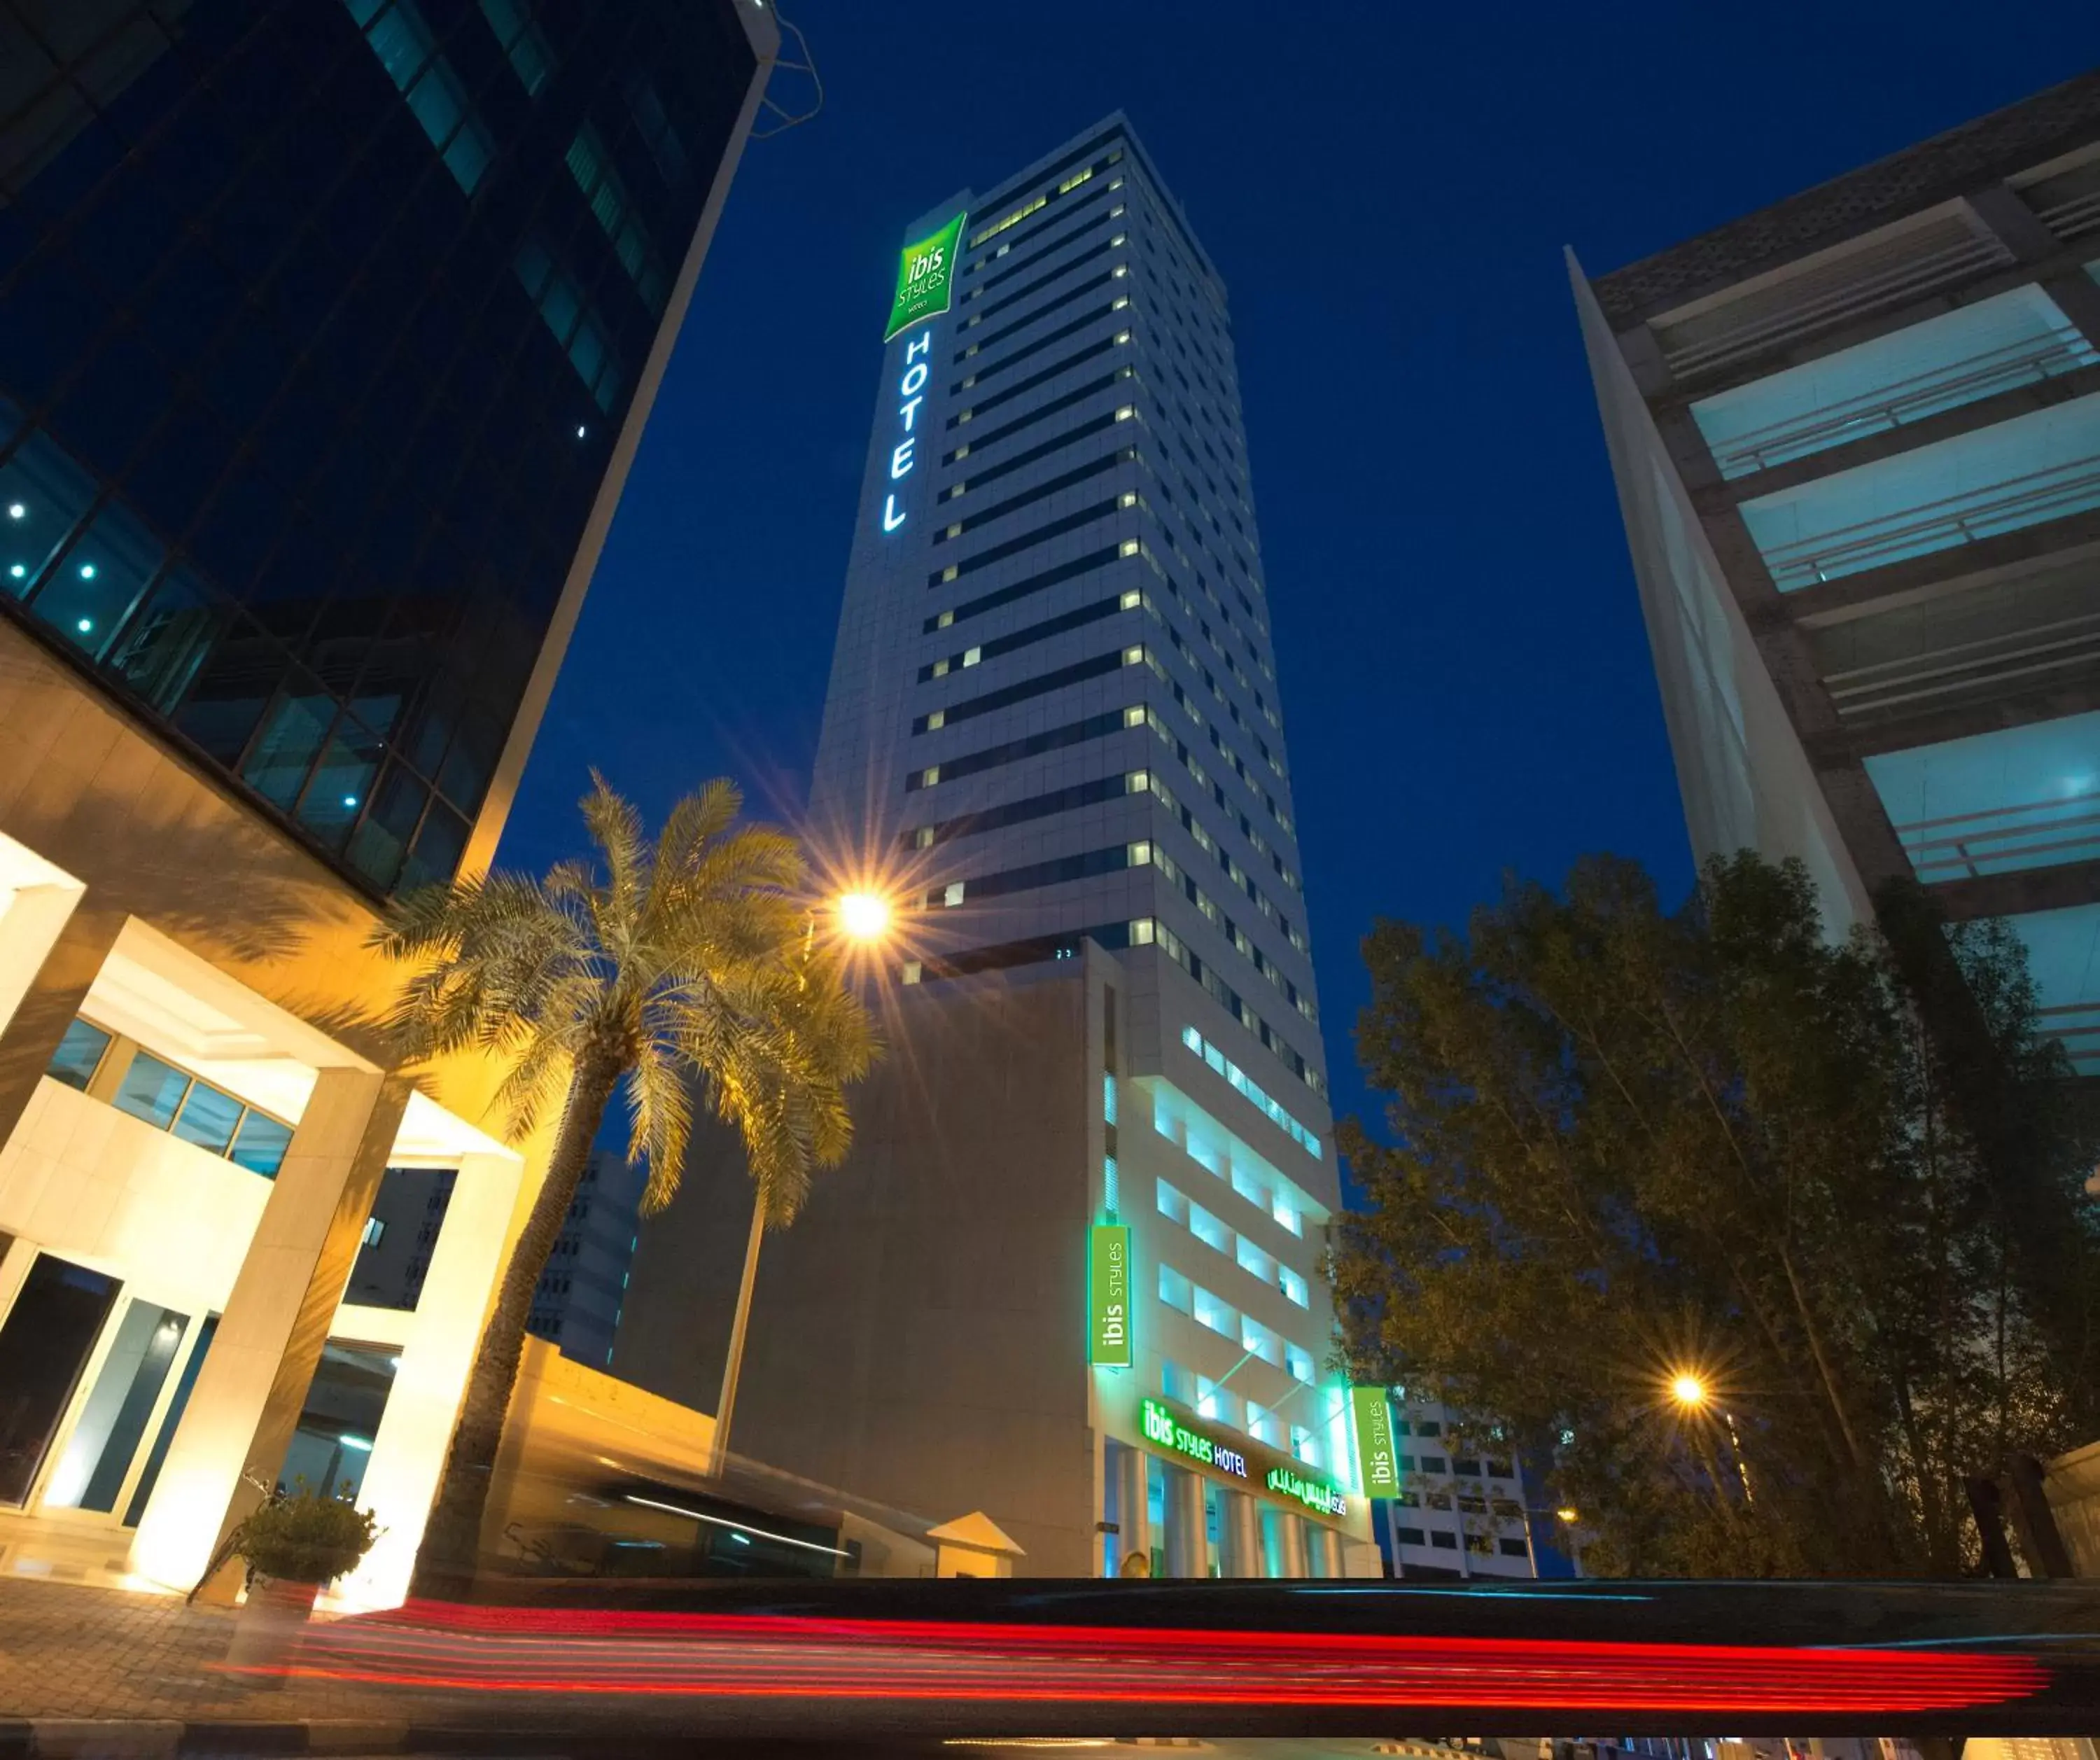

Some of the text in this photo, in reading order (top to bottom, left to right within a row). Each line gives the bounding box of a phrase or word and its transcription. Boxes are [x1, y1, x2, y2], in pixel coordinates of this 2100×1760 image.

[909, 246, 944, 284] ibis
[885, 332, 930, 531] HOTEL
[1102, 1304, 1123, 1346] ibis
[1144, 1399, 1173, 1446] ibis
[1214, 1445, 1247, 1478] HOTEL
[1370, 1451, 1391, 1484] ibis
